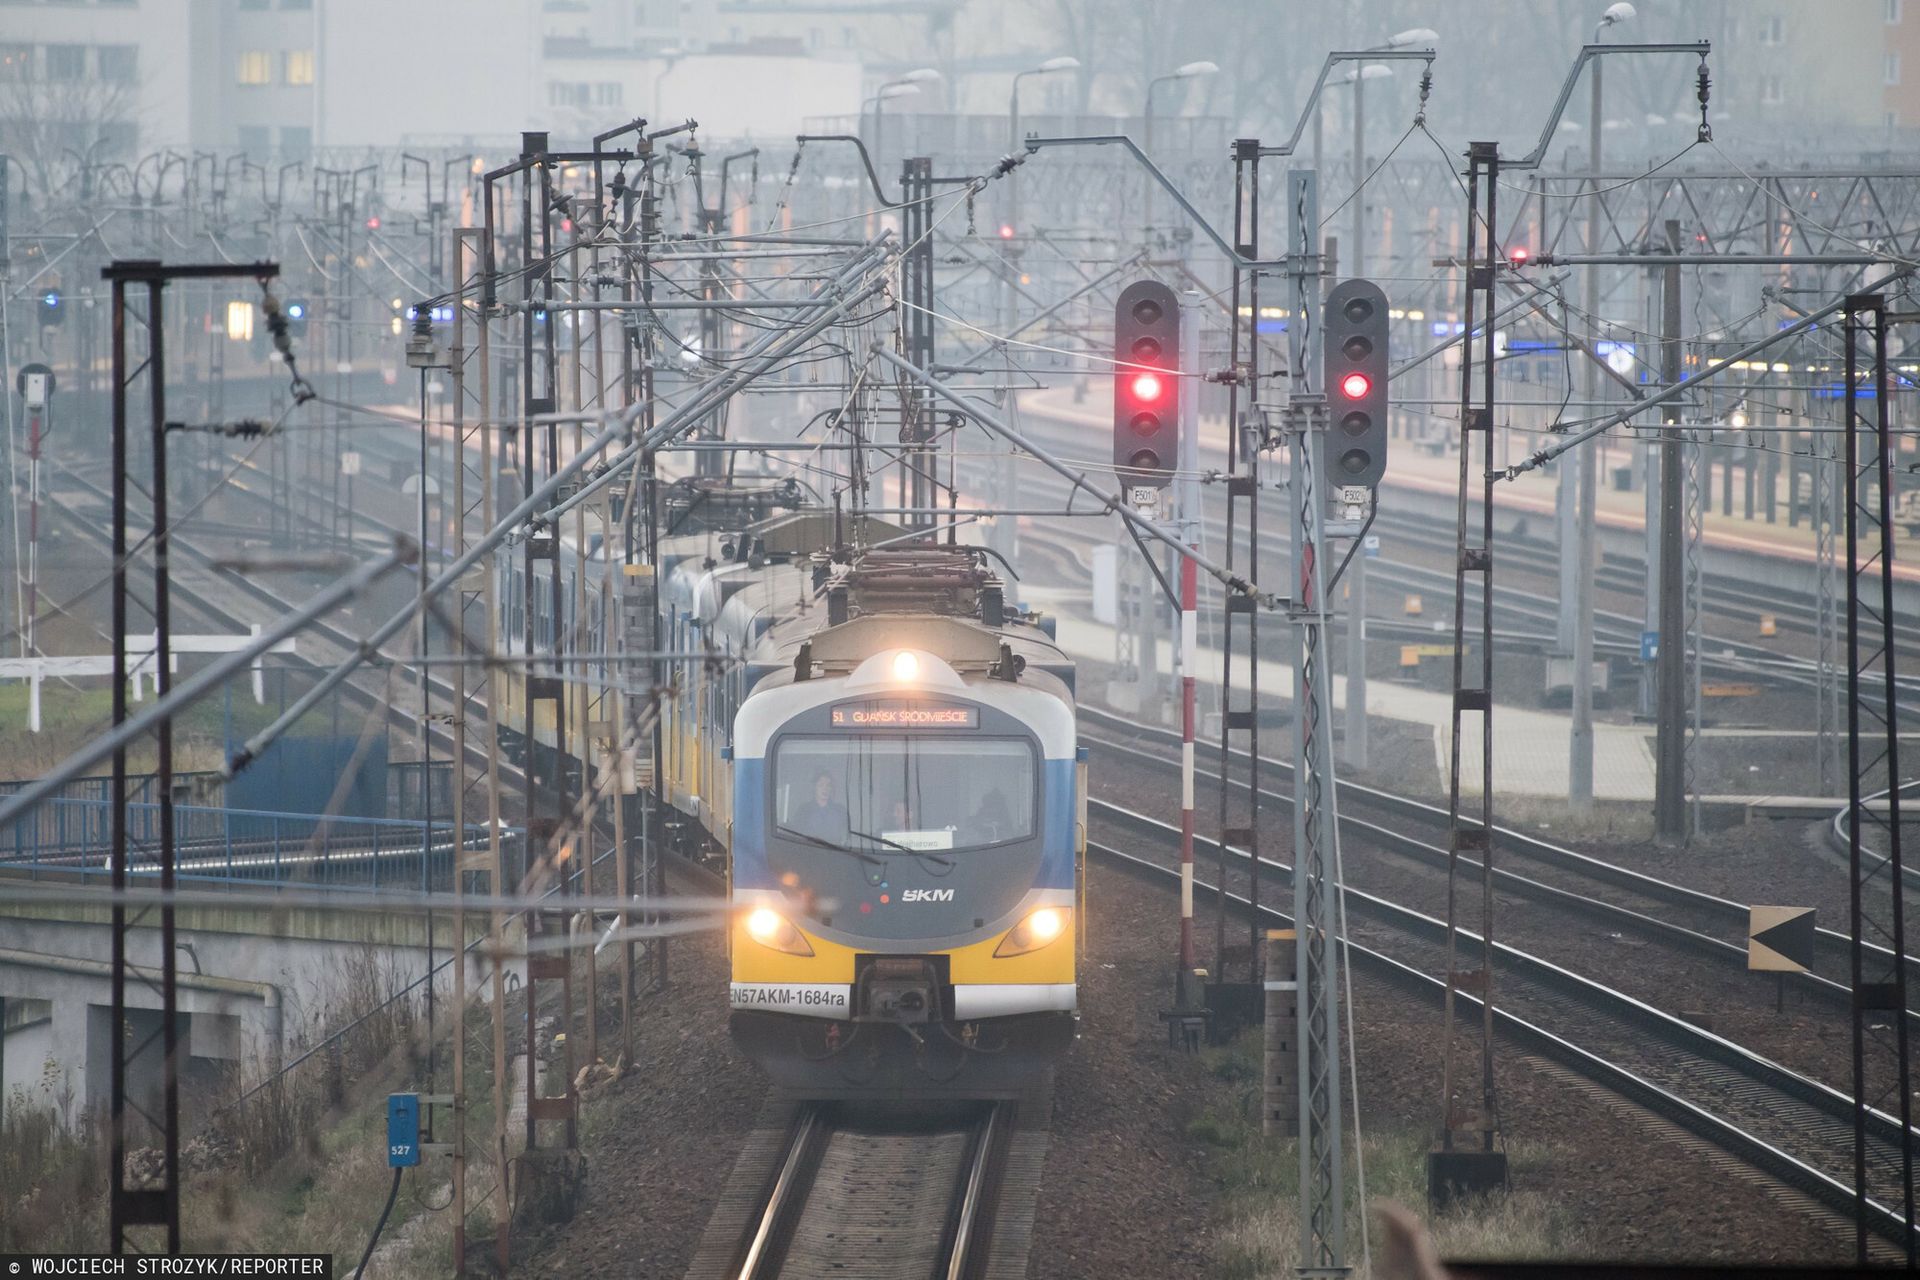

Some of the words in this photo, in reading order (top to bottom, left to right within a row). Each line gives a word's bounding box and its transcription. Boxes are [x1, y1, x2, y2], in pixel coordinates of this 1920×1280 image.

[1135, 490, 1151, 500] F501
[852, 710, 897, 722] GDAŃSK
[902, 889, 955, 902] SKM
[730, 988, 845, 1006] EN57AKM-1684ra
[391, 1146, 410, 1155] 527
